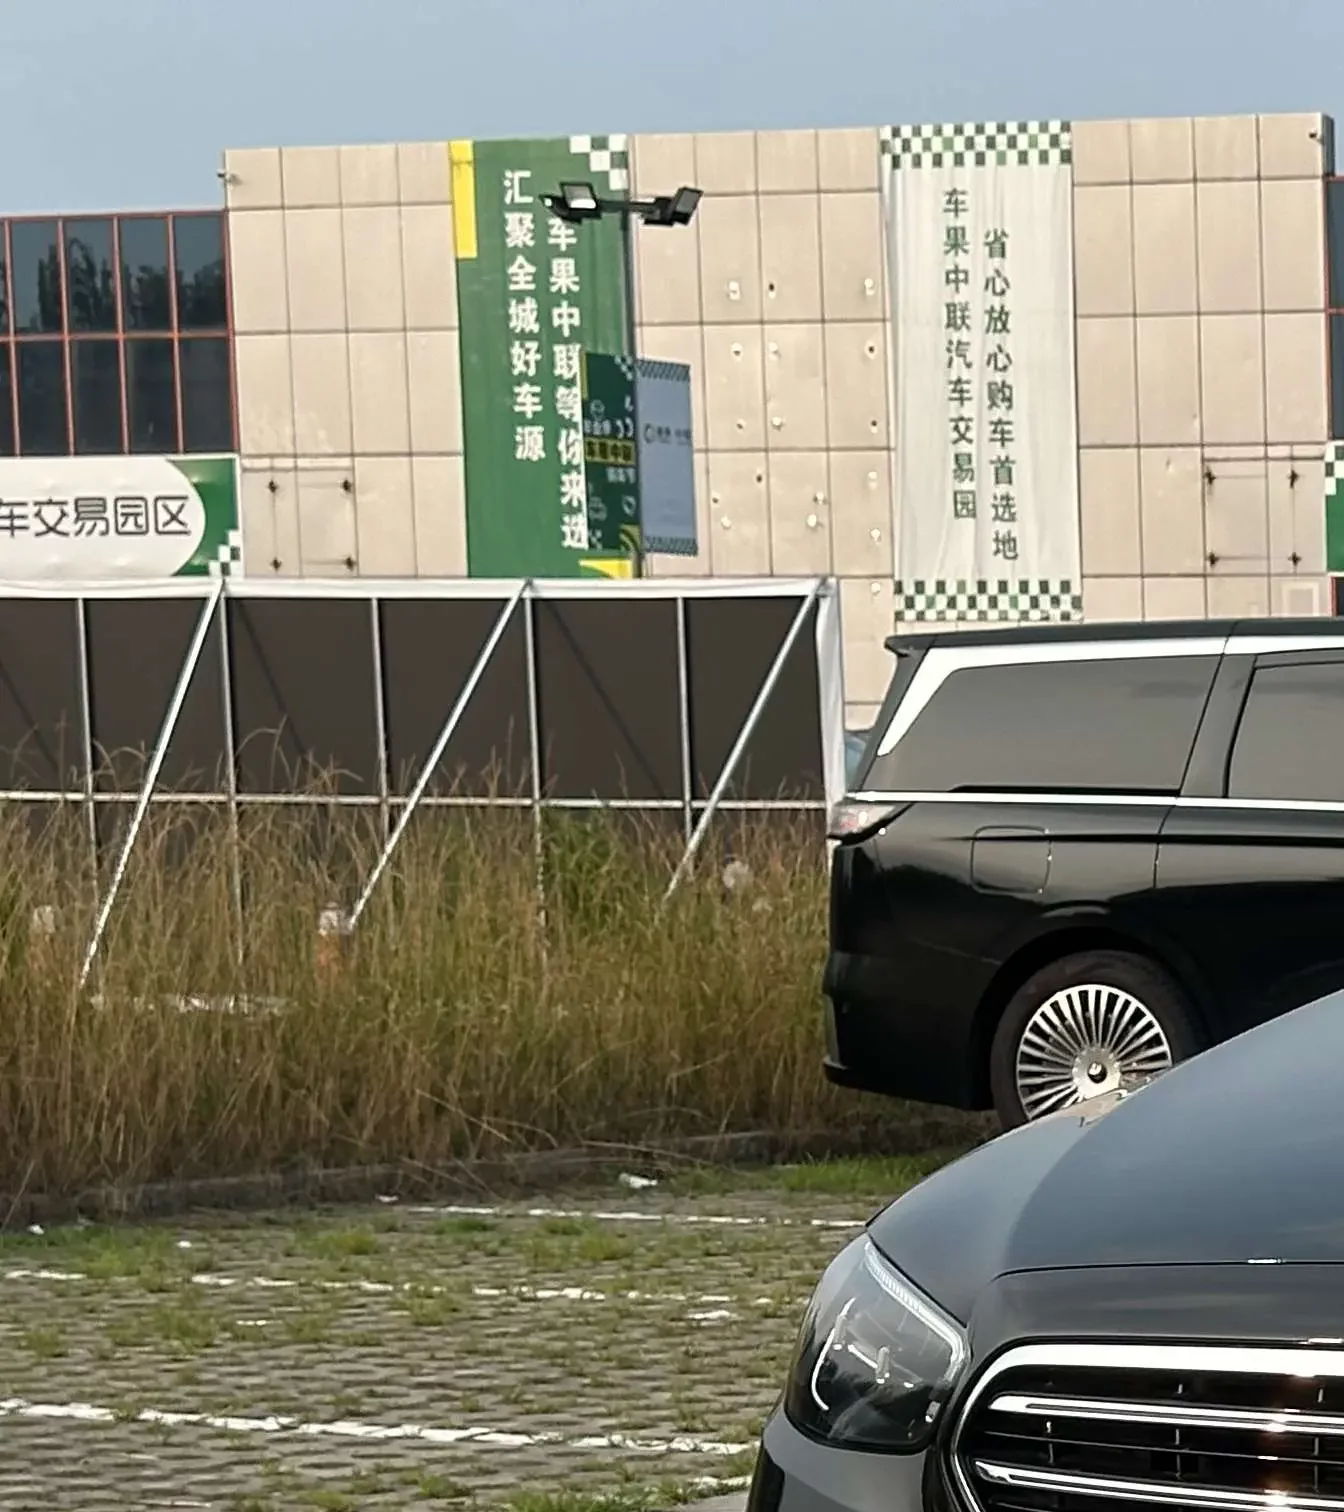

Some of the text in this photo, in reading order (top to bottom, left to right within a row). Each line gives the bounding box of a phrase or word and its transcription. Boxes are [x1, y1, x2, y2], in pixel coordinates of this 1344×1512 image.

[503, 170, 546, 461] 汇聚全城好车源
[942, 187, 977, 521] 车果中联汽车交易园
[983, 228, 1019, 561] 省心放心购车首选地
[0, 494, 191, 538] 车交易园区
